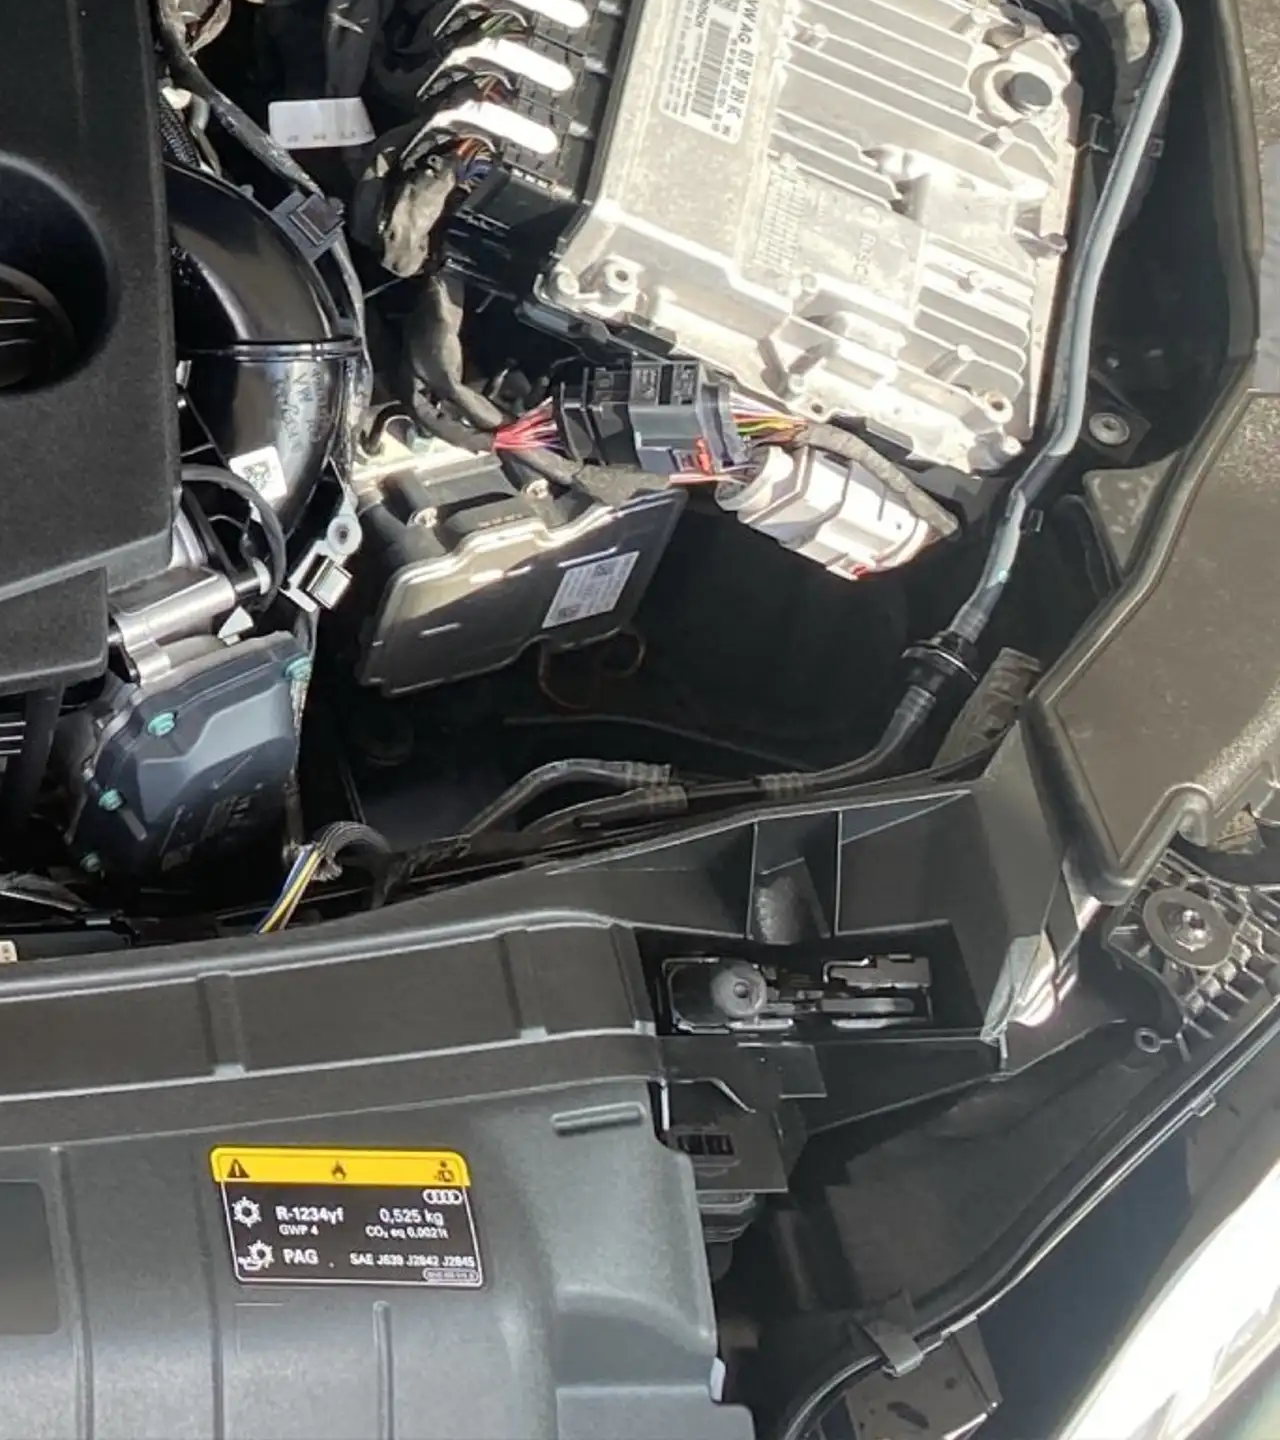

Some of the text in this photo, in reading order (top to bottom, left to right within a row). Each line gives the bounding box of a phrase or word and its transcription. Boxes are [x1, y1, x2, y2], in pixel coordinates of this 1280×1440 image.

[274, 1205, 444, 1227] R-1234yf 0,525 kg
[278, 1224, 308, 1236] GWP
[310, 1224, 320, 1236] 4
[282, 1248, 320, 1265] PAG
[349, 1252, 375, 1267] SAE
